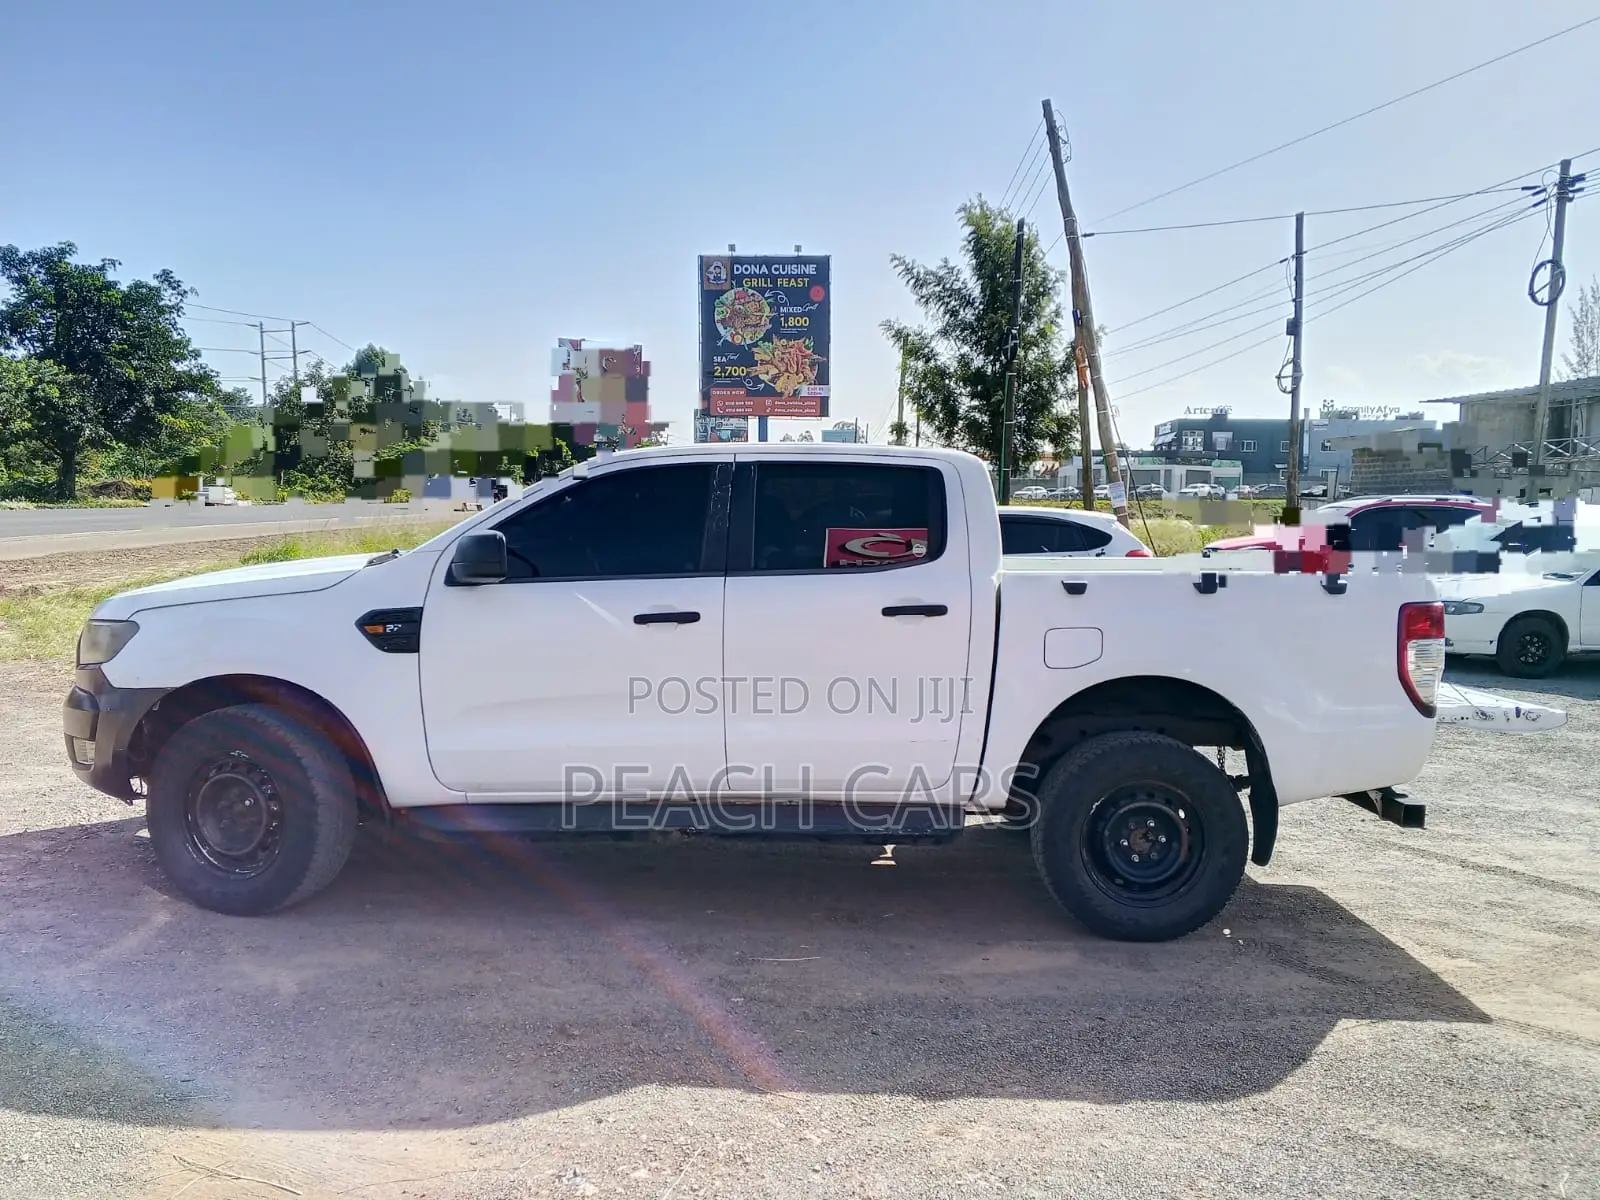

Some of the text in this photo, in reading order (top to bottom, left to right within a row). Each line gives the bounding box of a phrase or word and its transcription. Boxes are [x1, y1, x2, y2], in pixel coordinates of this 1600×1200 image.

[733, 264, 817, 275] DONA CUISINE
[743, 278, 810, 288] GRILL FEAST
[780, 316, 809, 328] 1,800
[713, 366, 747, 378] 2,700
